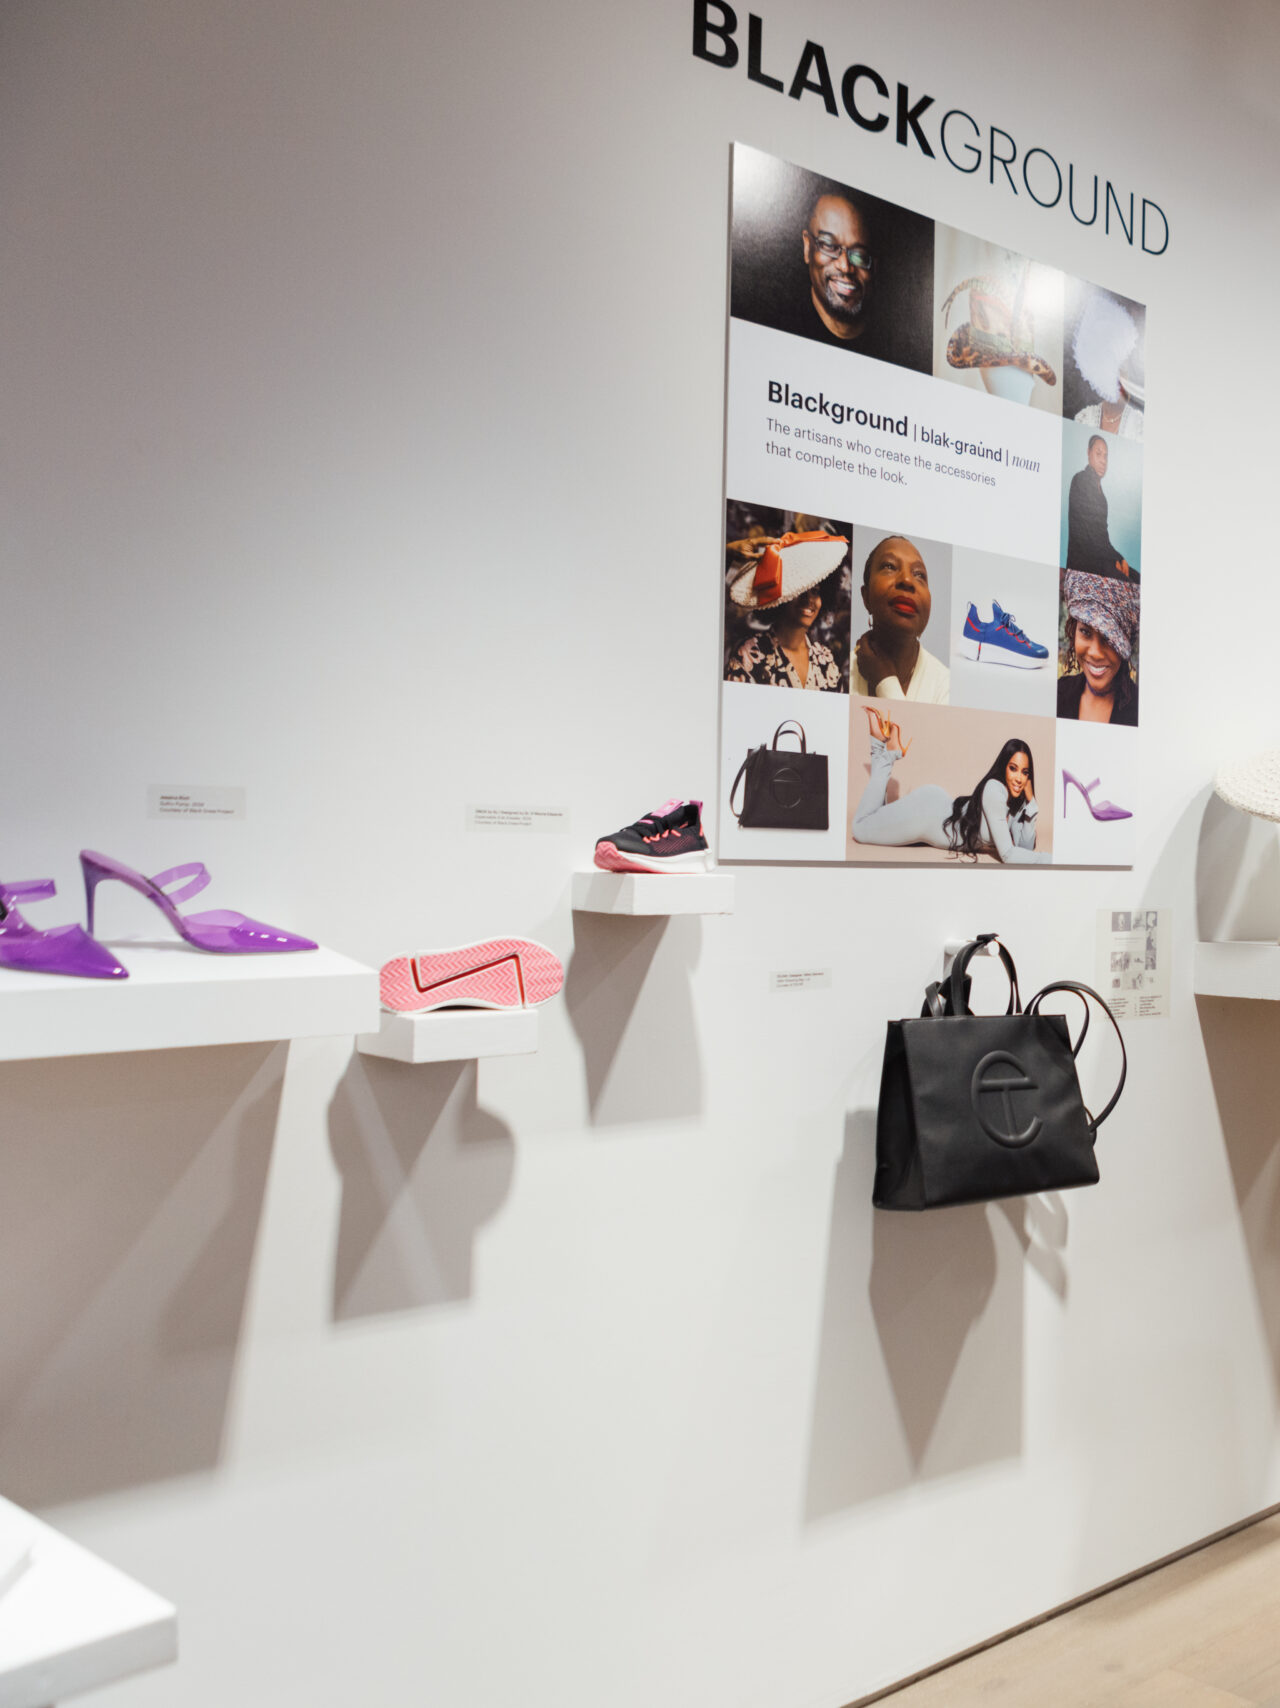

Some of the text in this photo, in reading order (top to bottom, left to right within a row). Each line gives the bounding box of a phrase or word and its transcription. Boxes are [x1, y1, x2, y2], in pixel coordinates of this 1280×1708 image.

[766, 417, 997, 487] The artisans who create the accessories
[767, 380, 909, 437] Blackground
[1012, 455, 1041, 473] noun
[765, 441, 908, 486] that complete the look.
